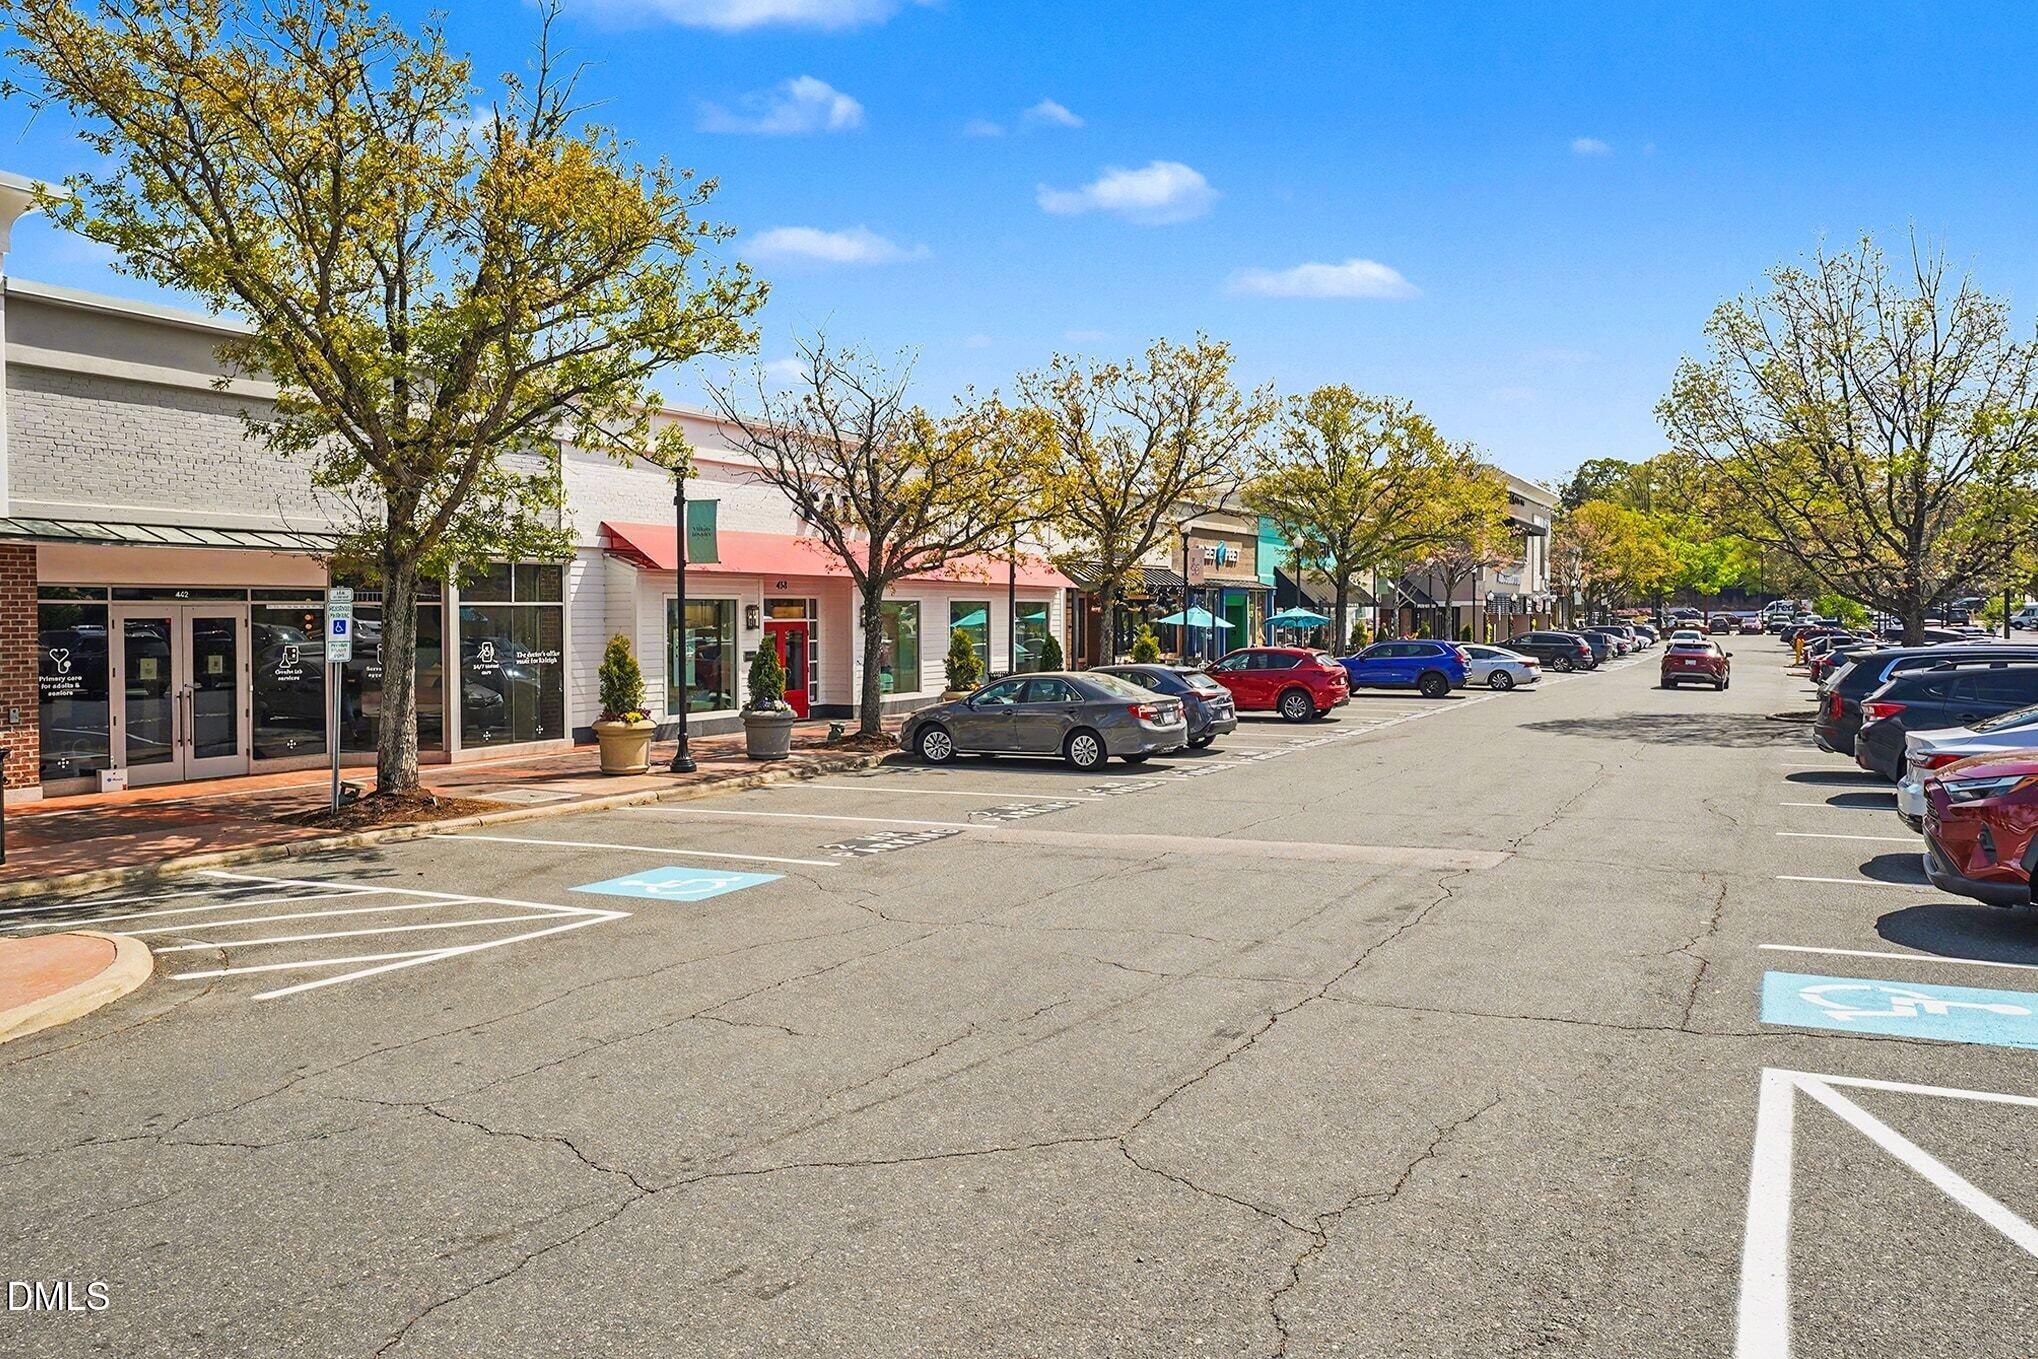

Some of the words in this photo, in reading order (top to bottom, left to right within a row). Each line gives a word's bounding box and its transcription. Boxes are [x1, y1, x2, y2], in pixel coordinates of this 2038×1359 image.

[775, 580, 788, 590] 458
[175, 591, 189, 599] 442
[830, 828, 960, 858] PARKING
